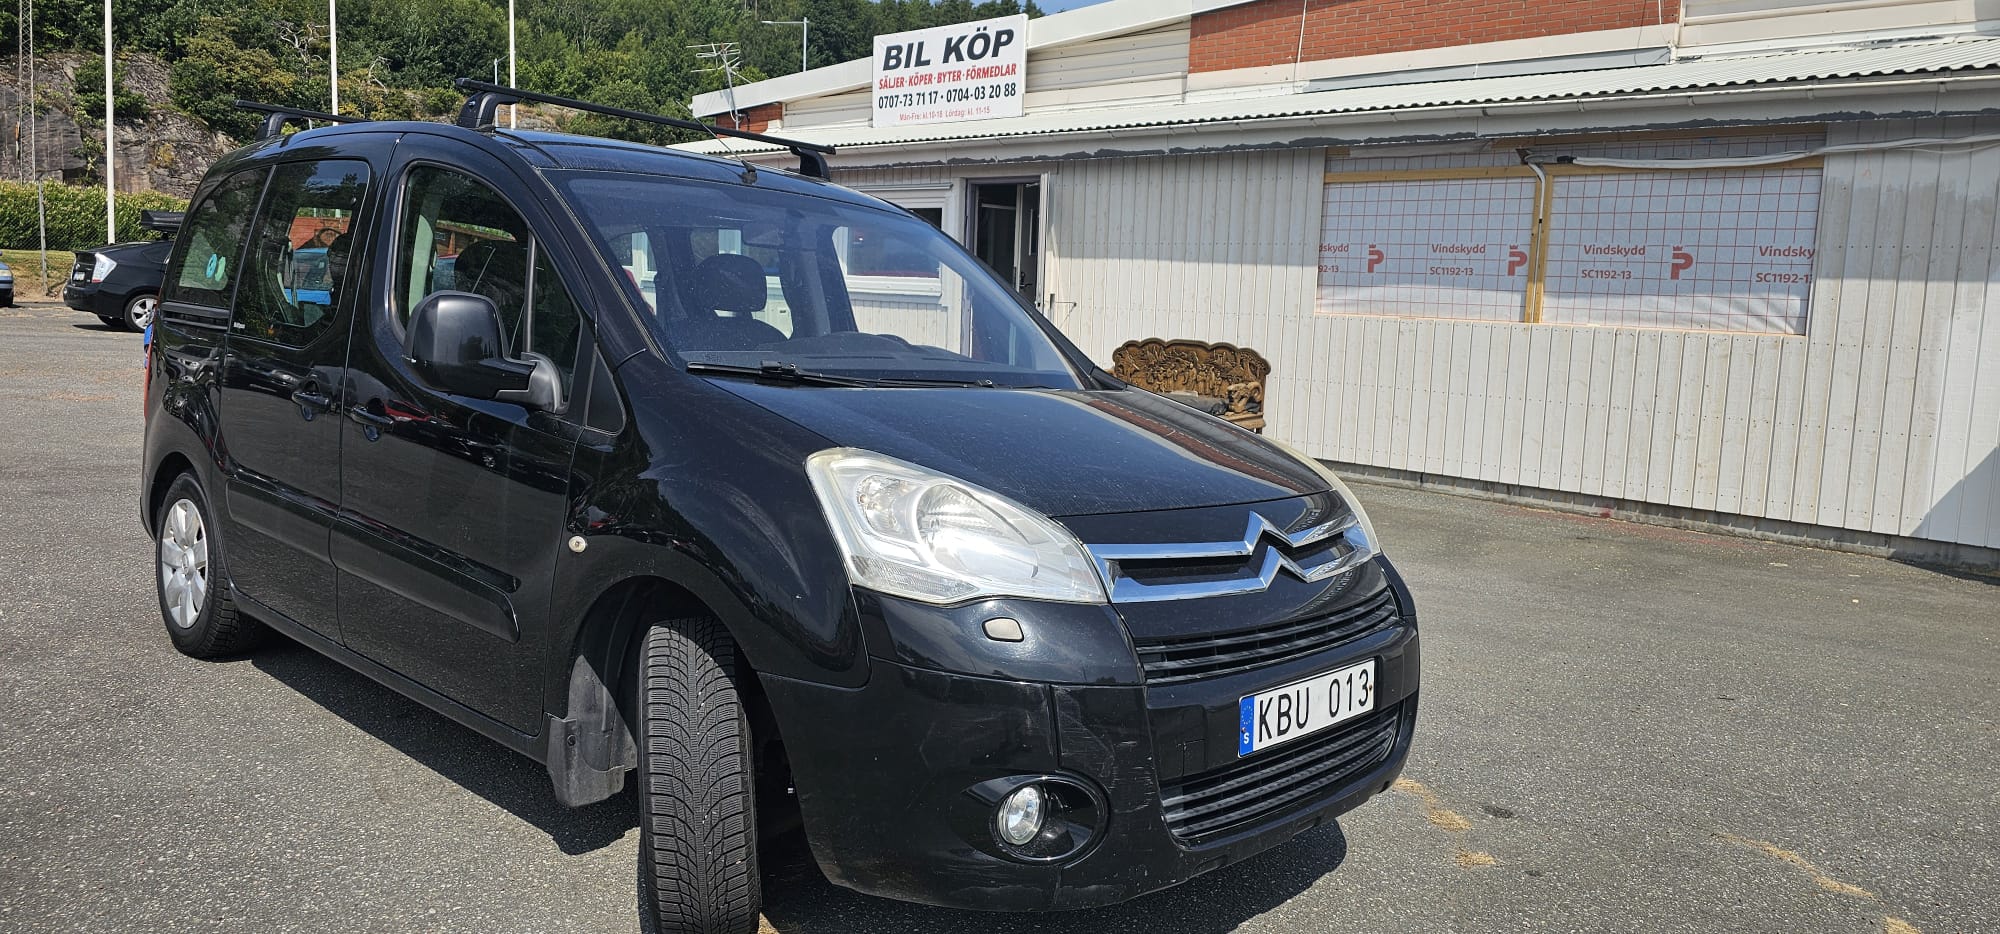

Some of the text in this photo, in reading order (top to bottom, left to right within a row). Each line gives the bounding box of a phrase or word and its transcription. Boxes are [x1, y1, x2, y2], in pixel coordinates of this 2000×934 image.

[882, 26, 1015, 71] BIL KÖP
[878, 82, 1016, 109] 0707-73 71 17 0704-03 20 88
[1431, 243, 1486, 255] Vindskydd
[1583, 244, 1646, 257] Vindskydd
[1429, 266, 1474, 276] SC1192-13
[1581, 269, 1632, 280] SC1192-13
[1755, 272, 1812, 284] SC1192-1
[1258, 668, 1369, 743] KBU 013
[1243, 732, 1250, 745] S
